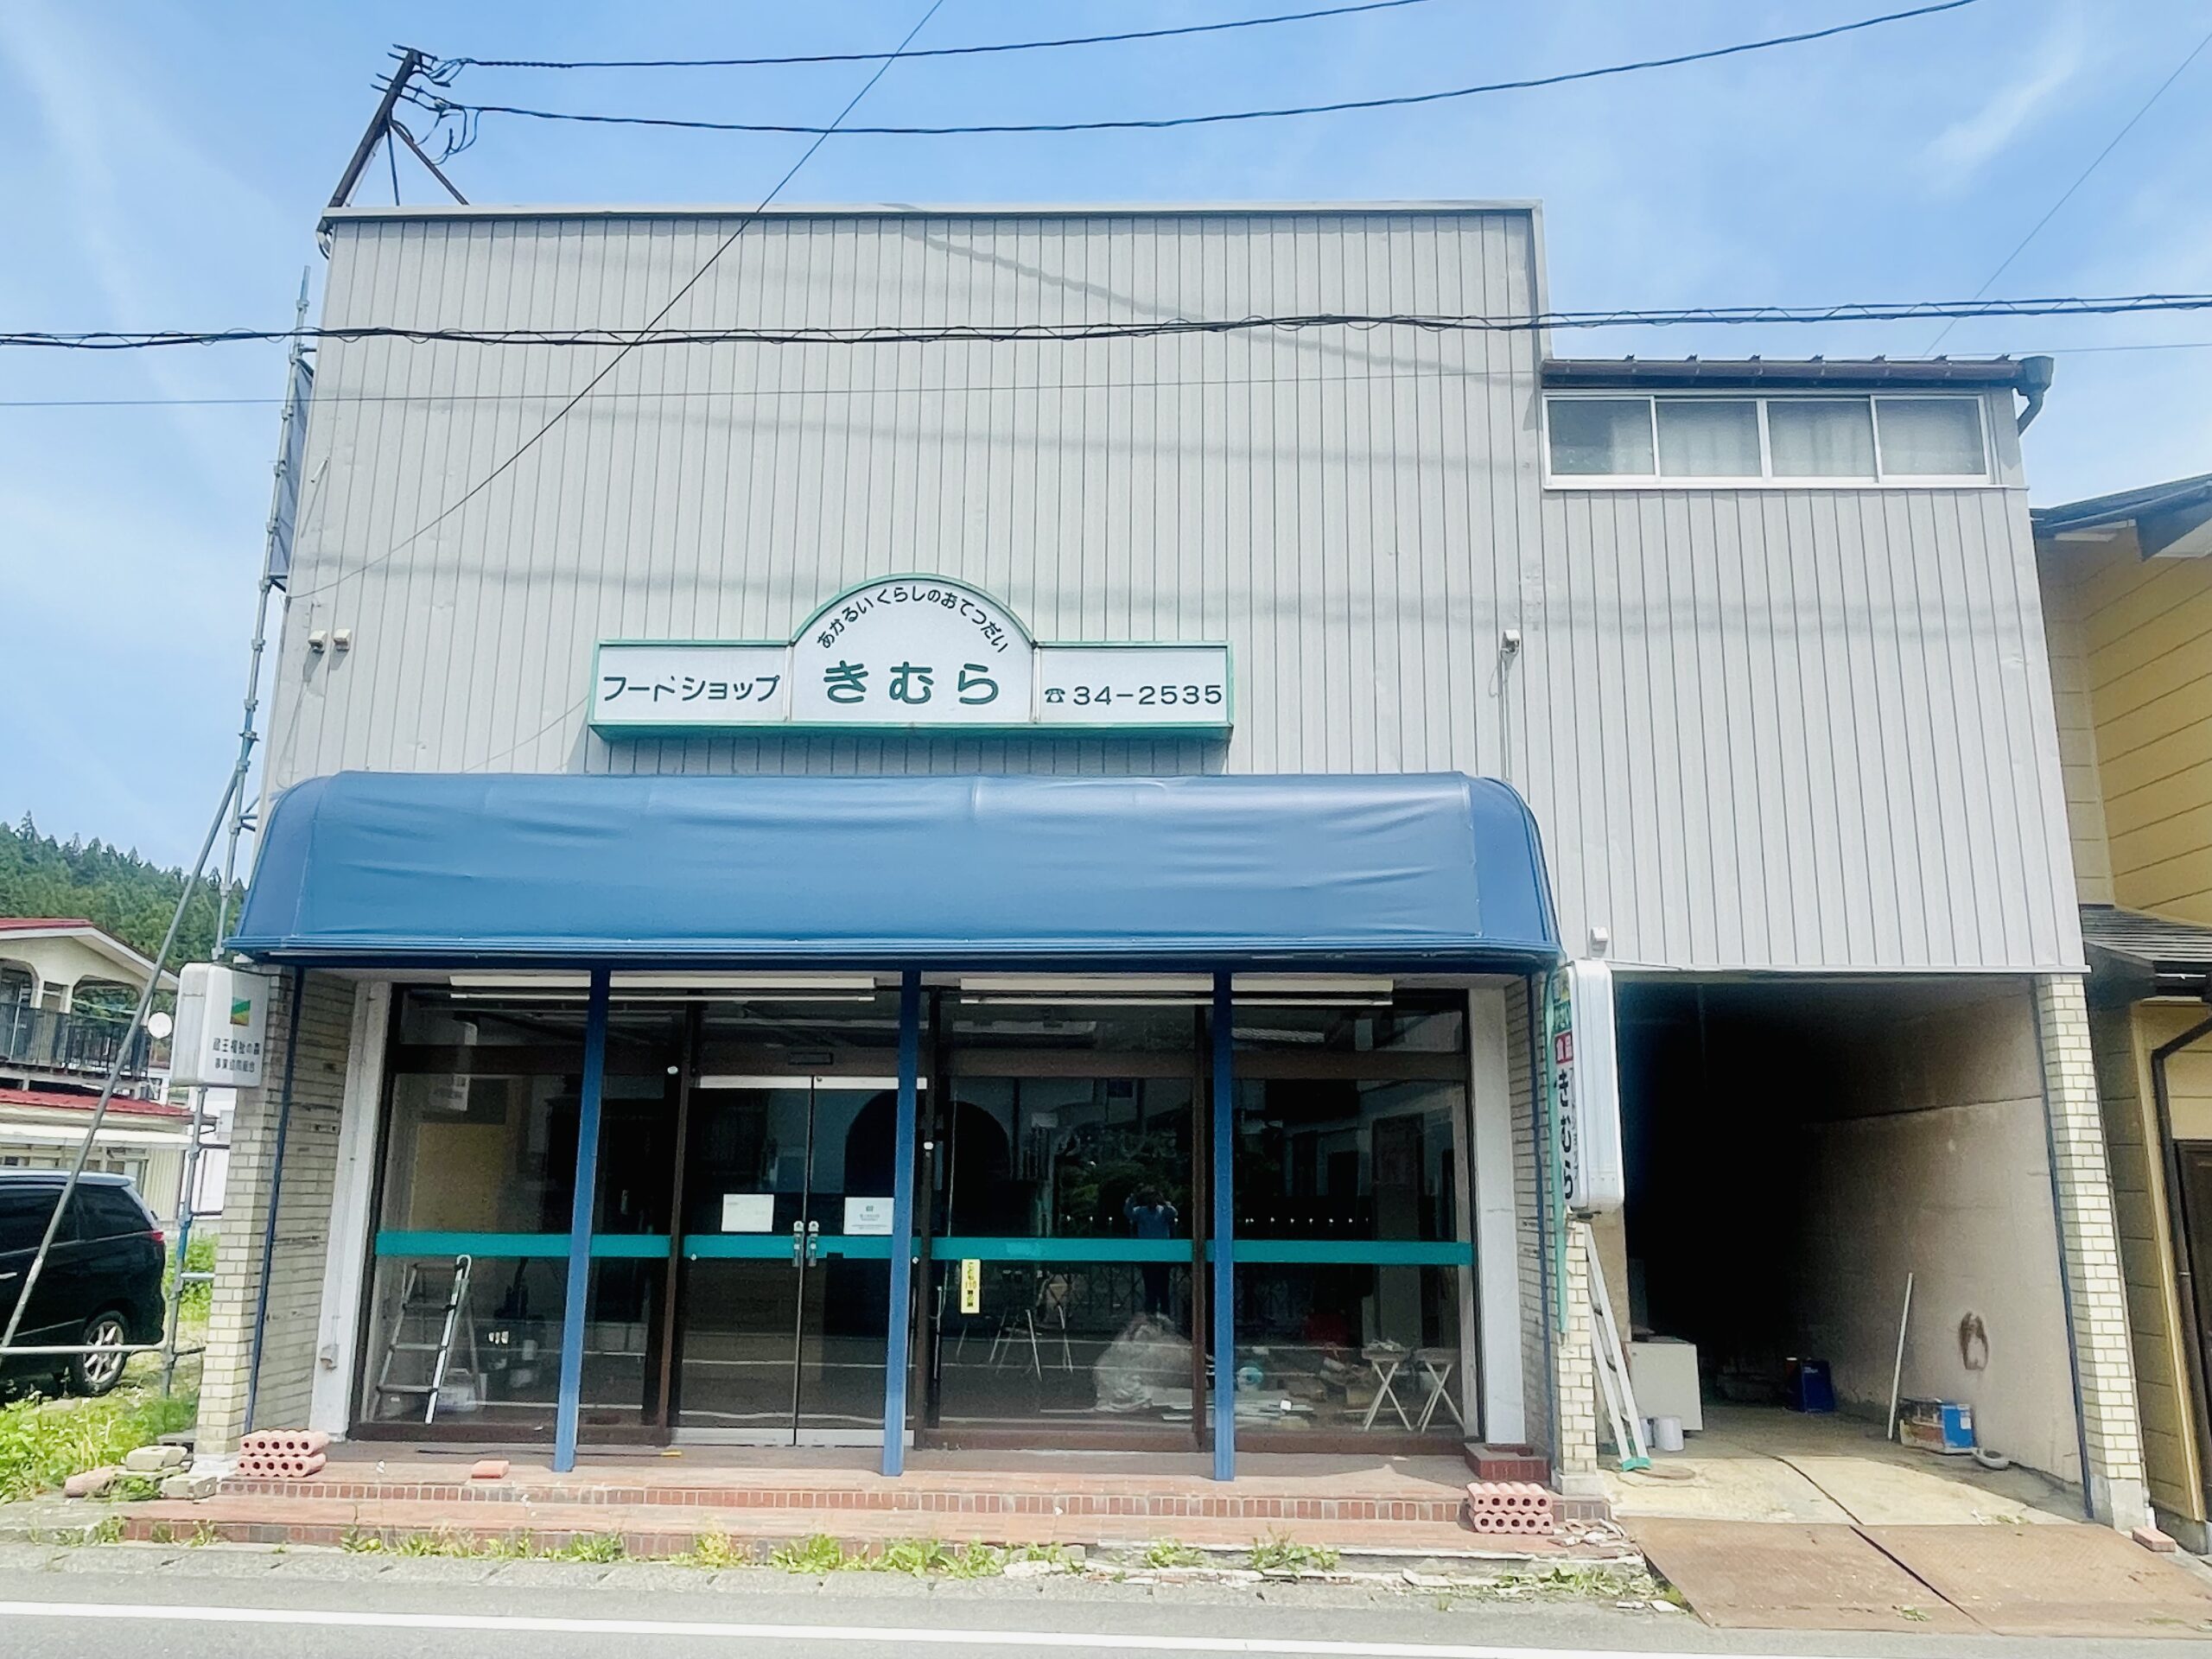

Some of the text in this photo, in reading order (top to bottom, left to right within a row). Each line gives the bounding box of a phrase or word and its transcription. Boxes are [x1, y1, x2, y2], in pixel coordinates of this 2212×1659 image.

[817, 586, 1008, 652] あかるいくらしのおてつだい
[603, 675, 780, 702] フードショップ
[823, 660, 999, 704] きむら
[1072, 684, 1222, 705] 34-2535
